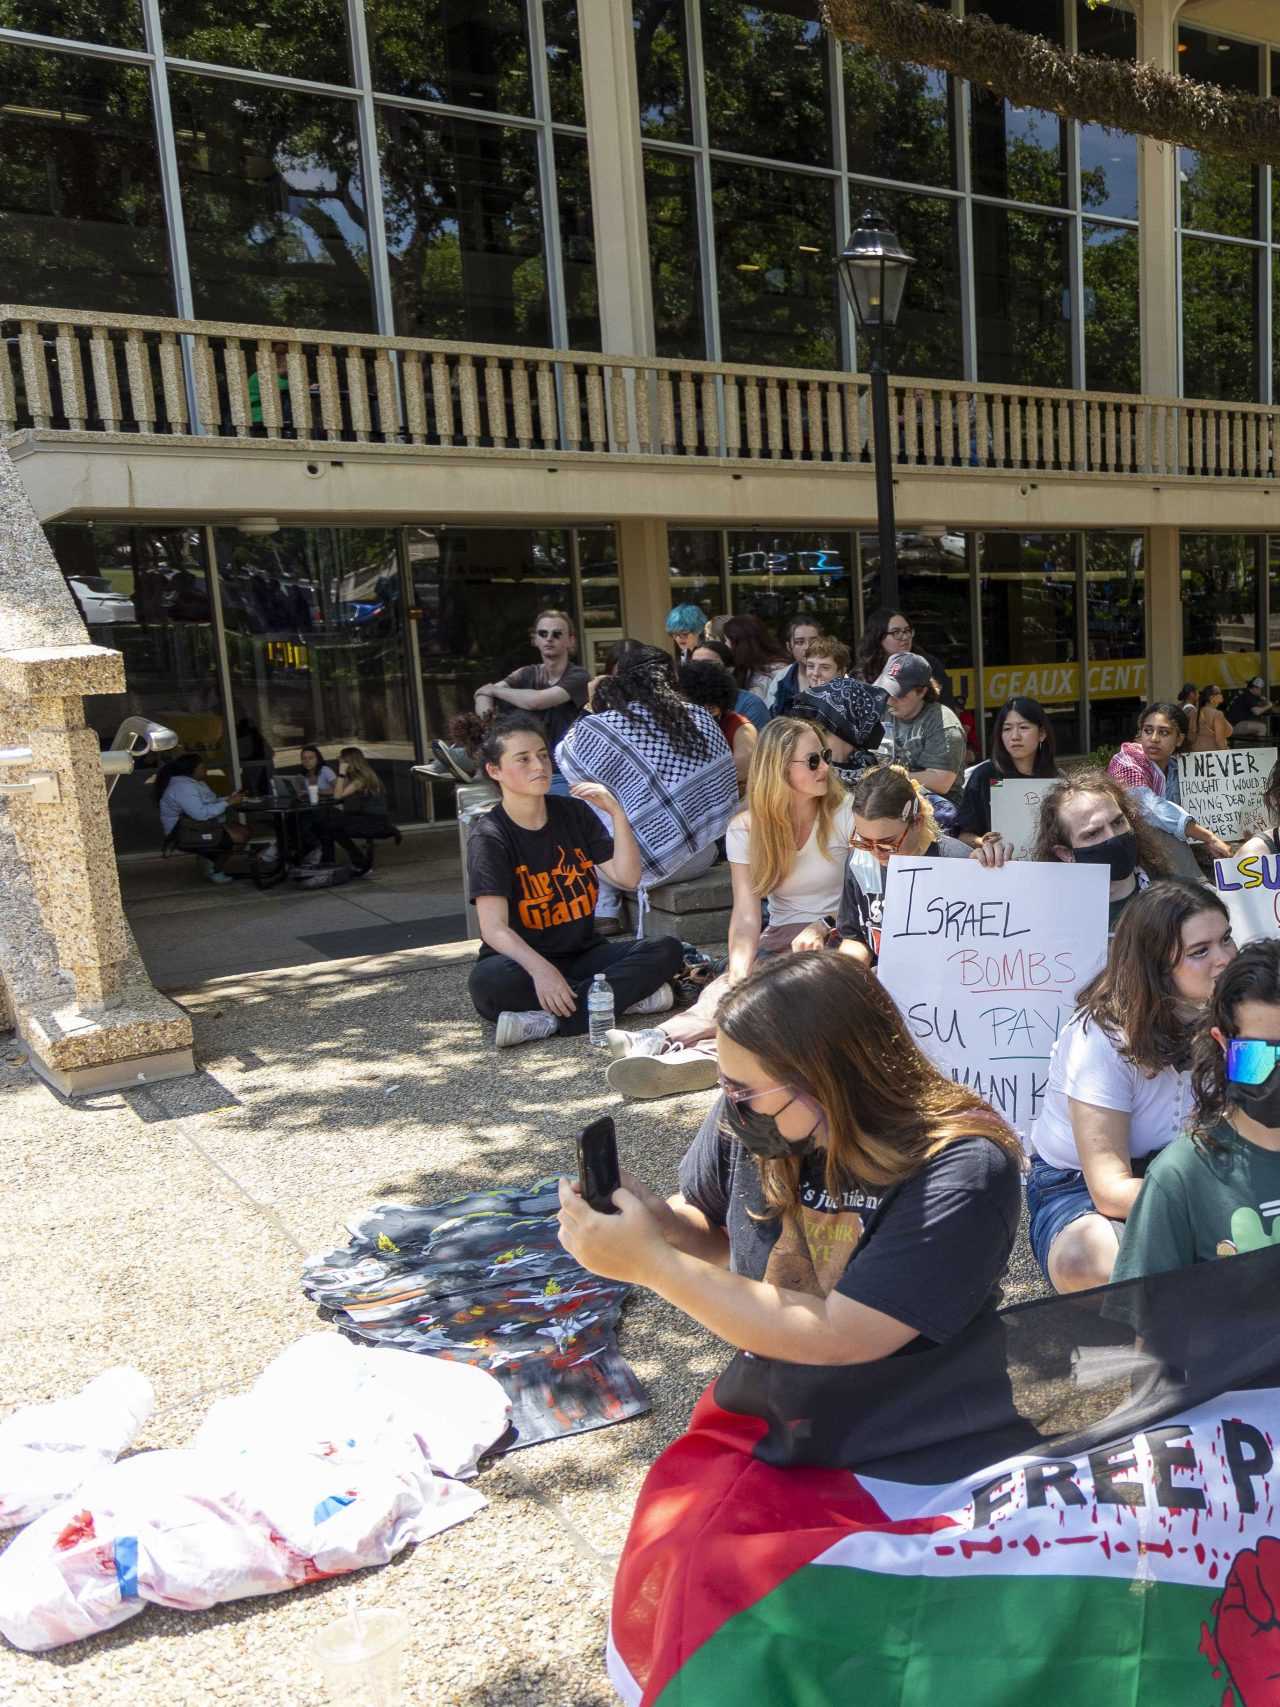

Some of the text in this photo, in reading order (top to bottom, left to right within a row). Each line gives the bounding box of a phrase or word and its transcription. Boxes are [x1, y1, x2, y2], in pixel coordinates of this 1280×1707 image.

[988, 669, 1075, 699] GEAUX
[1194, 752, 1259, 778] NEVER
[1180, 779, 1219, 797] THOUGHT
[1233, 779, 1259, 791] WOULD
[1187, 799, 1223, 815] AYING
[513, 864, 554, 900] The
[893, 867, 1031, 943] ISRAEL
[947, 948, 1077, 990] BOMBS
[907, 1002, 967, 1049] SU
[971, 1424, 1207, 1530] FREE
